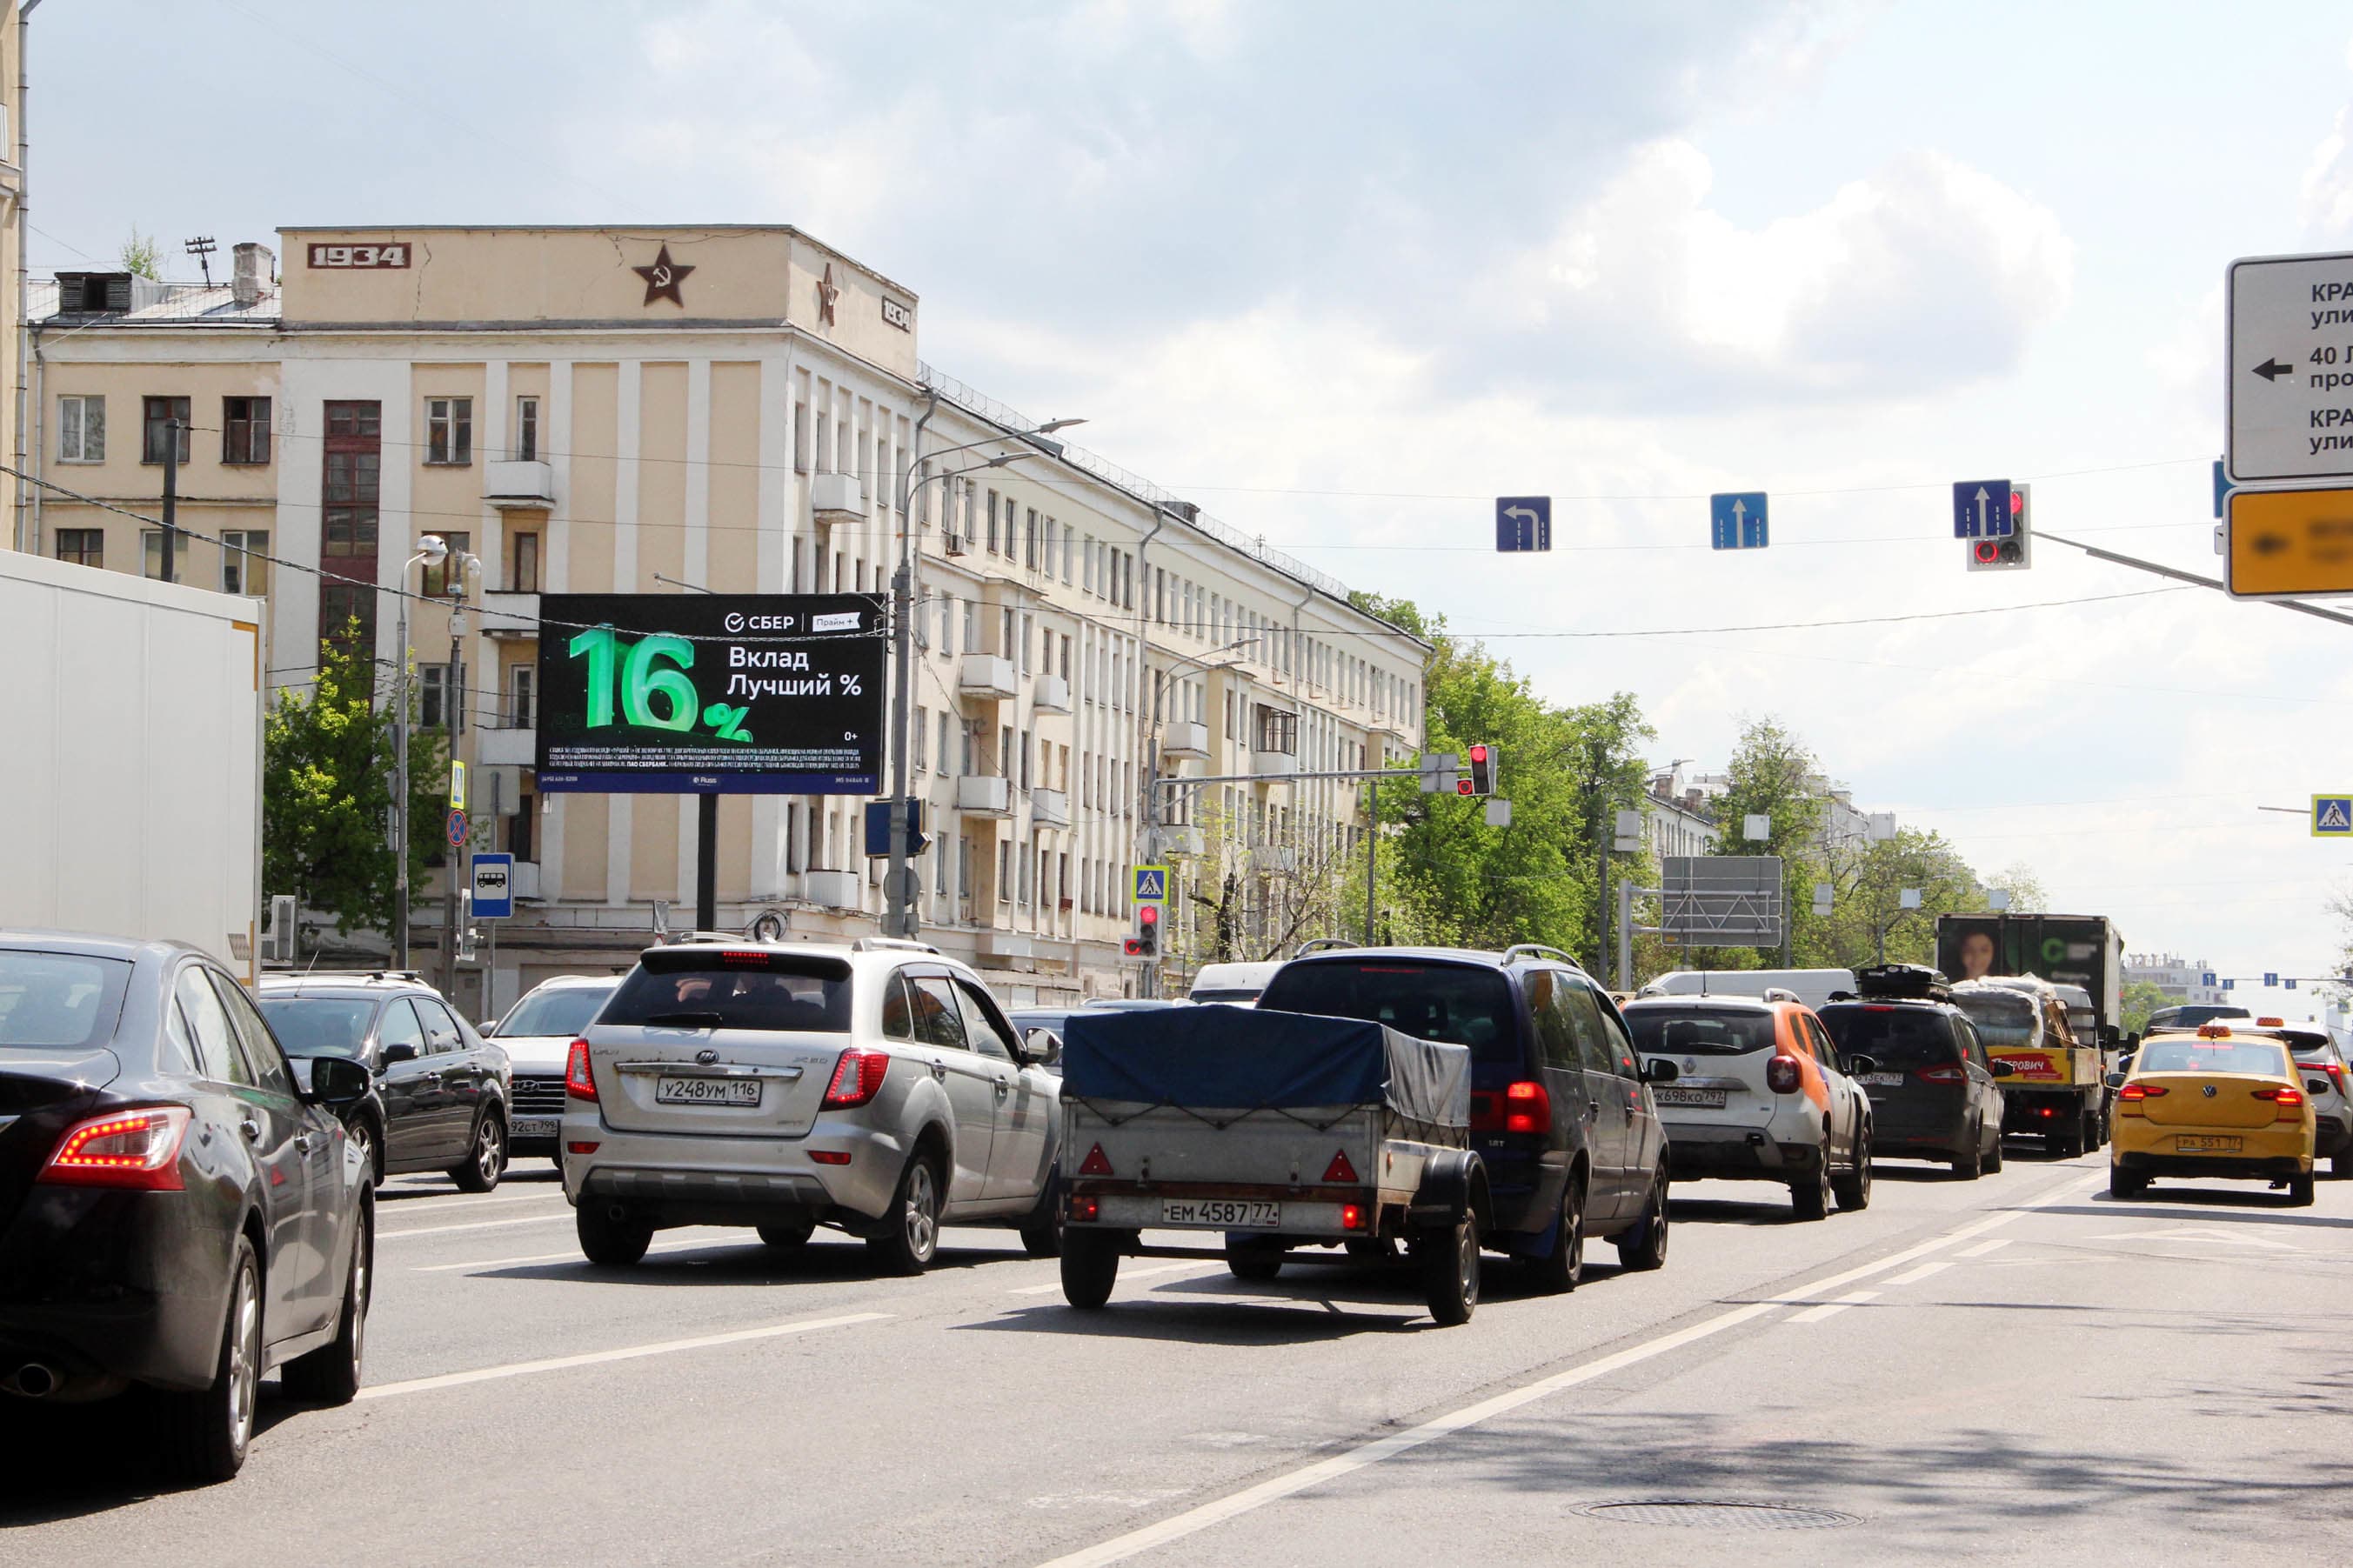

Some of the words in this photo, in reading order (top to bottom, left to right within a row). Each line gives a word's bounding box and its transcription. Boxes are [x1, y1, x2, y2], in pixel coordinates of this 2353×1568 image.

[313, 246, 404, 266] 1934
[2311, 282, 2353, 303] КРА
[884, 299, 911, 331] 1934
[2310, 310, 2353, 330] ули
[2310, 347, 2337, 365] 40
[2310, 372, 2353, 391] про
[2310, 409, 2353, 428] КРА
[2309, 436, 2353, 455] ули
[748, 616, 794, 630] СБЕР
[816, 617, 845, 627] Прайм
[729, 646, 810, 671] Вклад
[727, 672, 831, 700] Лучший
[839, 674, 862, 696] %
[844, 731, 858, 741] 0+
[665, 1080, 726, 1099] У248УМ
[732, 1083, 756, 1096] 116
[1656, 1091, 1702, 1104] К698КО
[511, 1121, 538, 1132] 92СТ
[1169, 1205, 1195, 1221] ЕМ
[1199, 1203, 1248, 1224] 4587
[1253, 1203, 1273, 1218] 77
